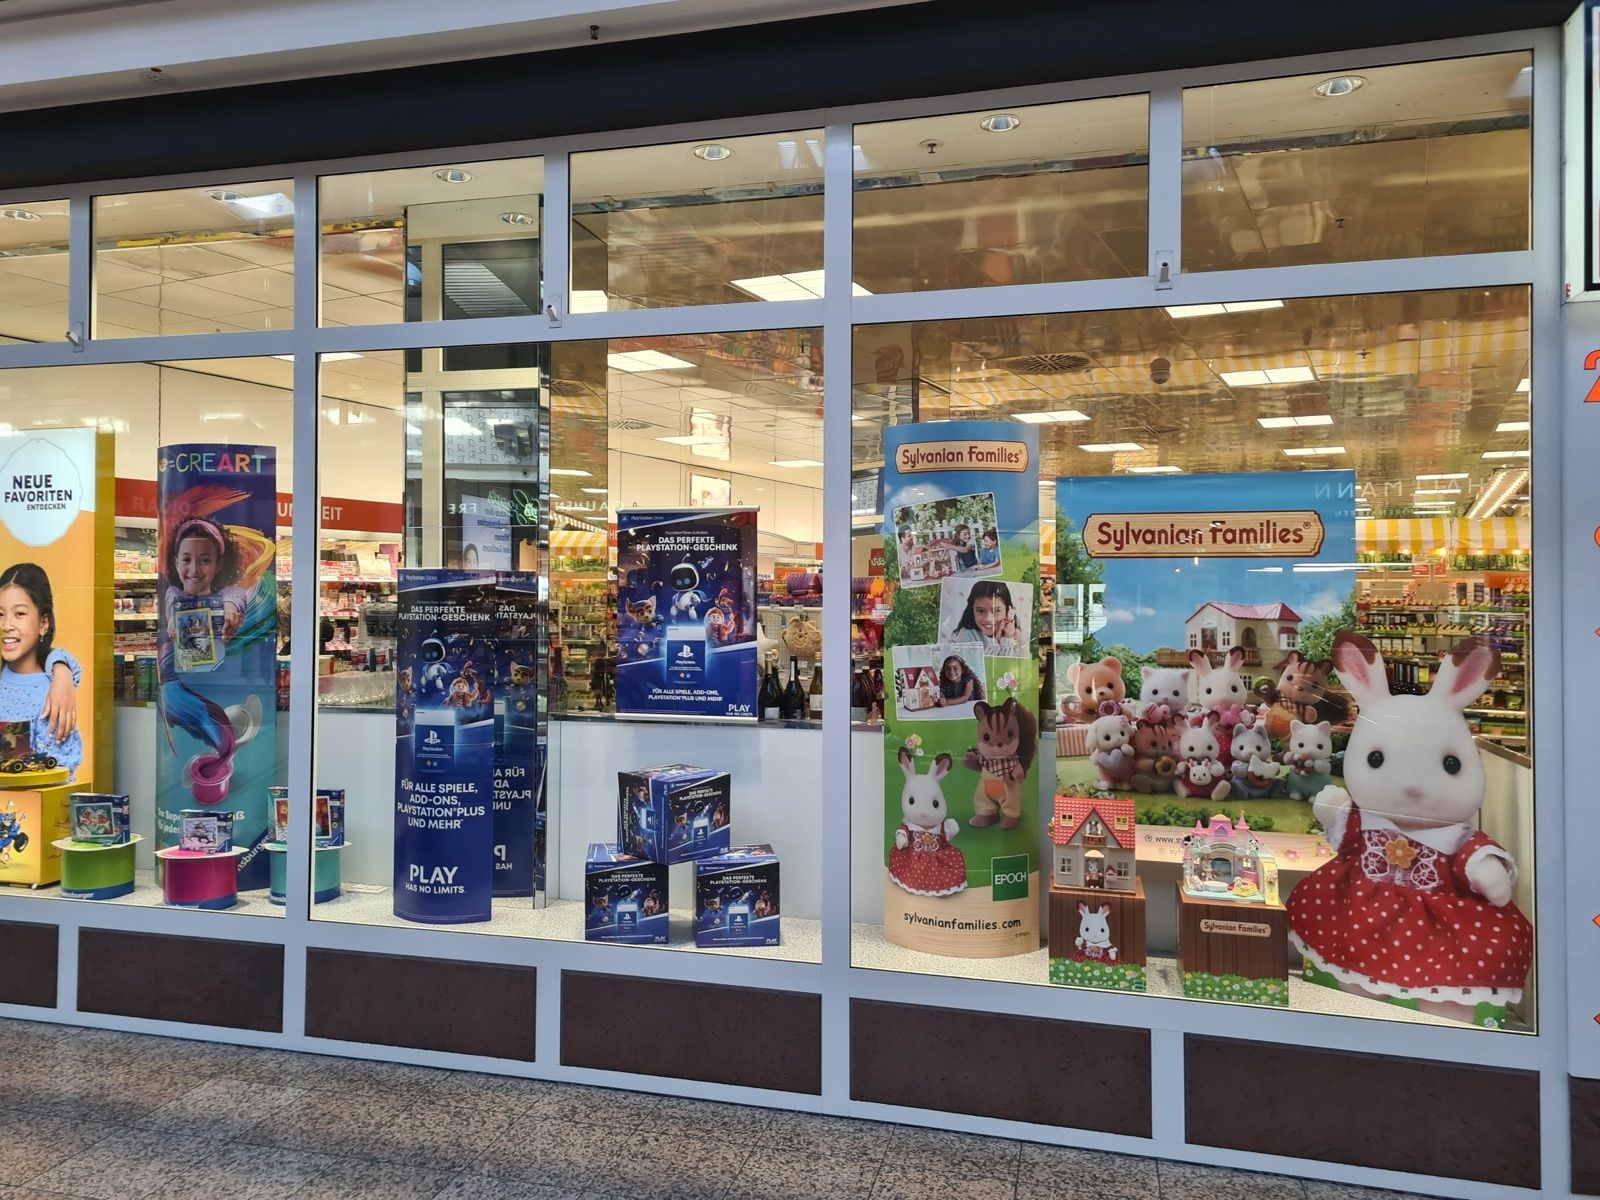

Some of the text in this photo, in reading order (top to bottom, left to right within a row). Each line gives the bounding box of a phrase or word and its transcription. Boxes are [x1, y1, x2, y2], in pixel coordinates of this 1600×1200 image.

[902, 448, 964, 468] Sylvanian
[13, 474, 53, 490] NEUE
[4, 490, 73, 503] FAVORITEN
[27, 503, 66, 511] ENTDECKEN
[1097, 521, 1203, 551] Sylvanian
[411, 605, 423, 613] DAS
[398, 613, 491, 622] PLAYSTATION-GESCHENK
[728, 704, 750, 712] PLAY
[401, 779, 413, 791] FÜR
[414, 784, 436, 793] ALLE
[408, 816, 426, 828] UND
[409, 863, 458, 884] PLAY
[995, 871, 1027, 885] EPOCH
[405, 882, 465, 894] HAS NO LIMITS
[904, 912, 1021, 931] sylvanianfamilies.com
[1204, 921, 1237, 932] Sylvanian
